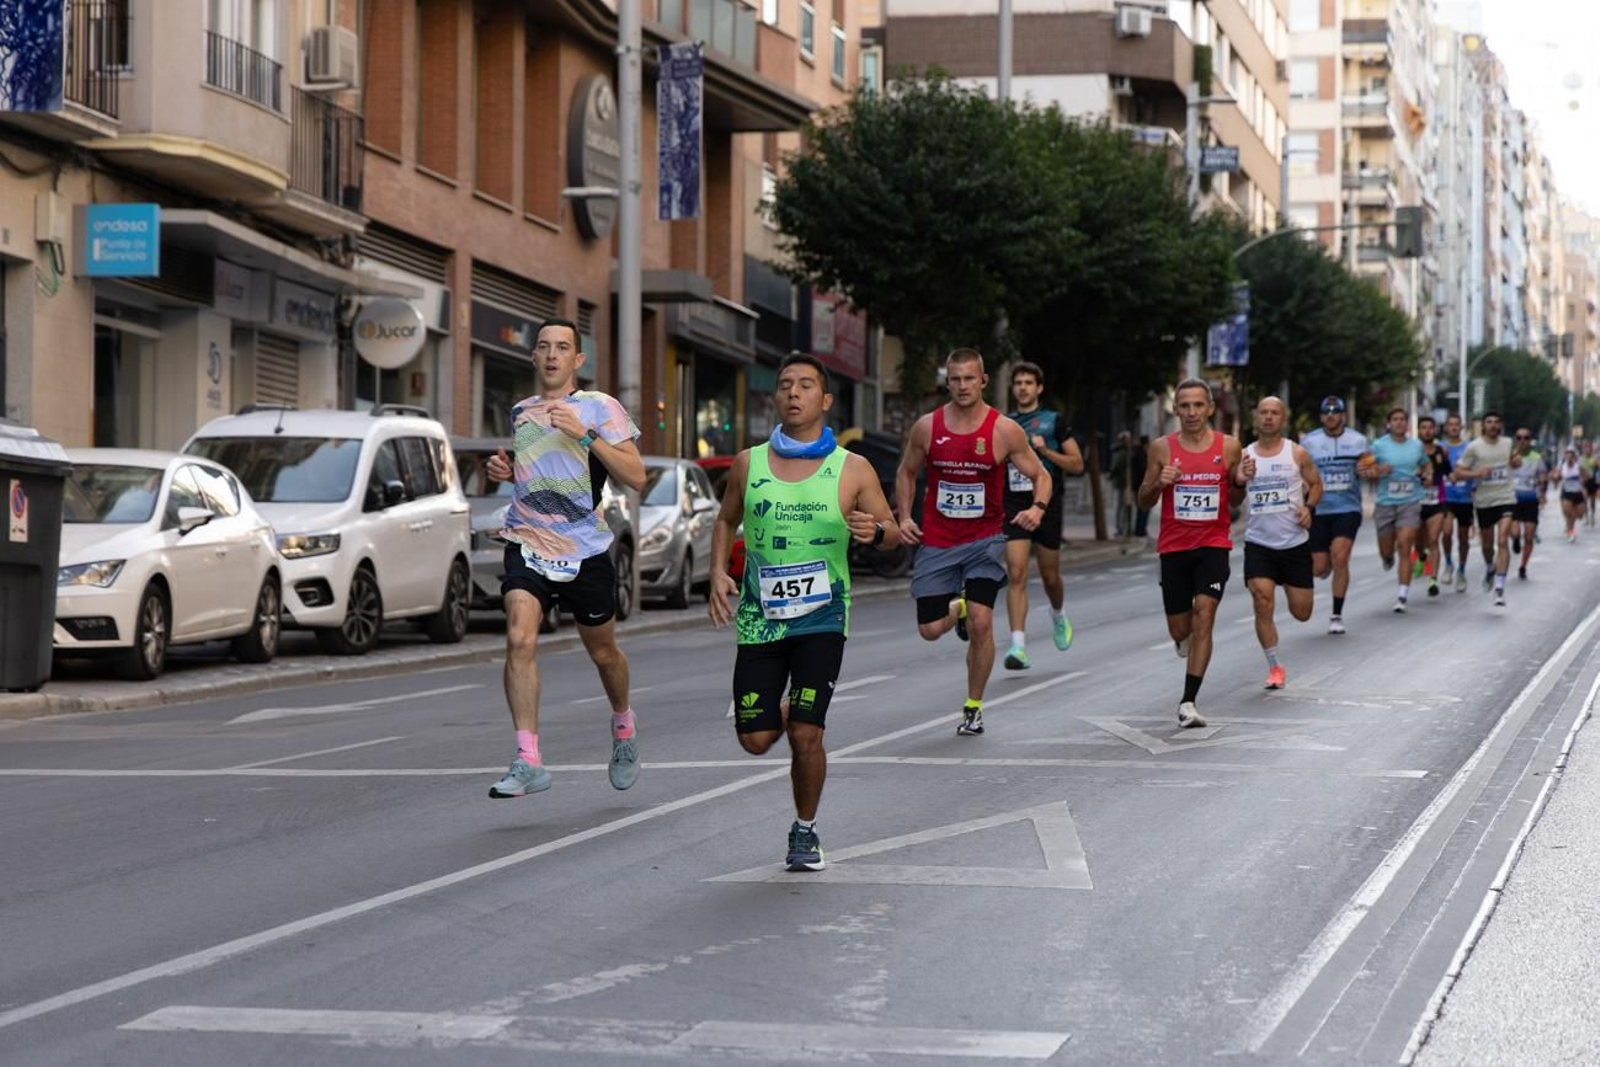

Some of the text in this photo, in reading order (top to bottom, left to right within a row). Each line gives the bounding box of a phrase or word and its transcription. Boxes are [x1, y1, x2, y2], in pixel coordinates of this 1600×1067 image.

[94, 219, 147, 232] endesa
[945, 492, 975, 505] 213
[1183, 495, 1211, 507] 751
[1254, 491, 1280, 503] 973
[775, 501, 828, 512] Fundación
[775, 512, 813, 524] Unicaja
[771, 576, 815, 599] 457
